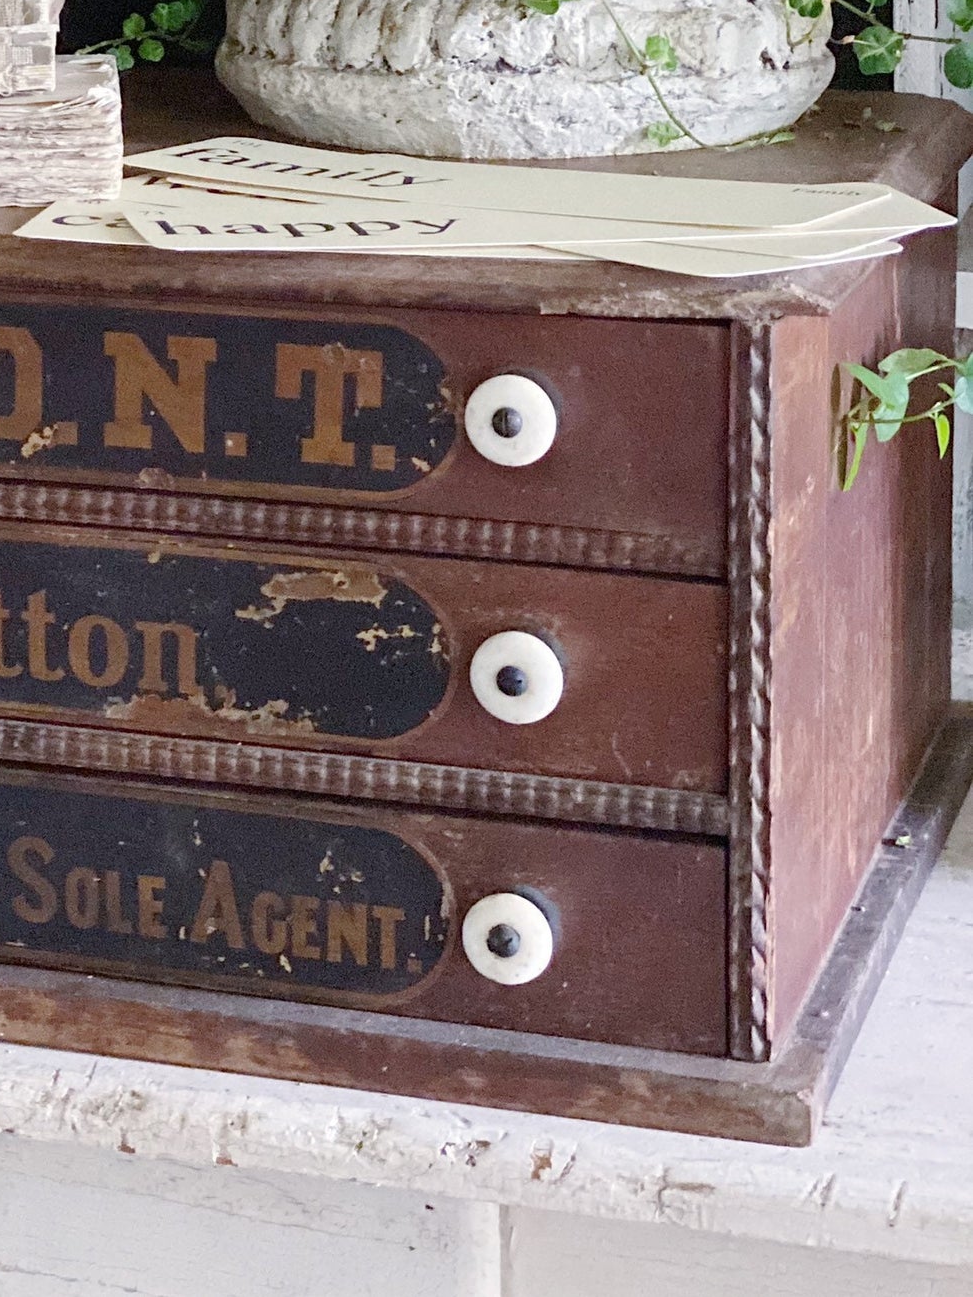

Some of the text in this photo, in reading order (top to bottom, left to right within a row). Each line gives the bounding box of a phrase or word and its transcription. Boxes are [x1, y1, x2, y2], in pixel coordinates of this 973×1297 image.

[169, 147, 451, 187] family
[149, 217, 461, 238] happy
[6, 834, 168, 940] SOLE
